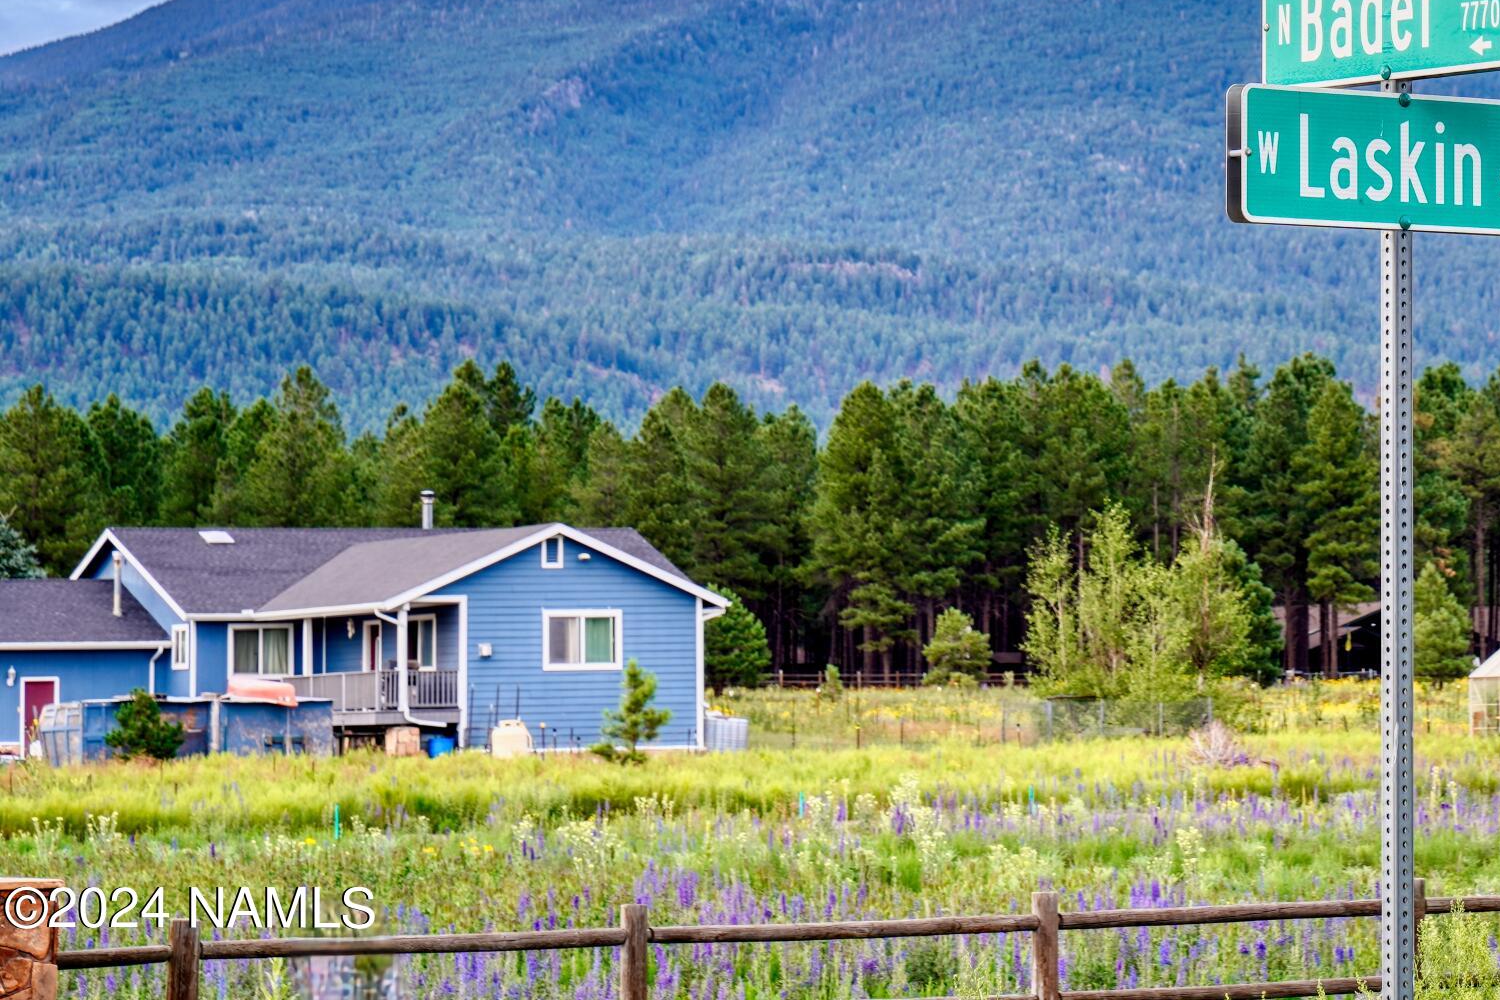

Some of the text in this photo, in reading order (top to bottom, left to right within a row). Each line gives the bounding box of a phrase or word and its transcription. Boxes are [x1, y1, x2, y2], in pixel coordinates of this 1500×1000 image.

[1278, 3, 1290, 45] N
[1258, 130, 1279, 175] W
[1300, 113, 1482, 207] Laskin
